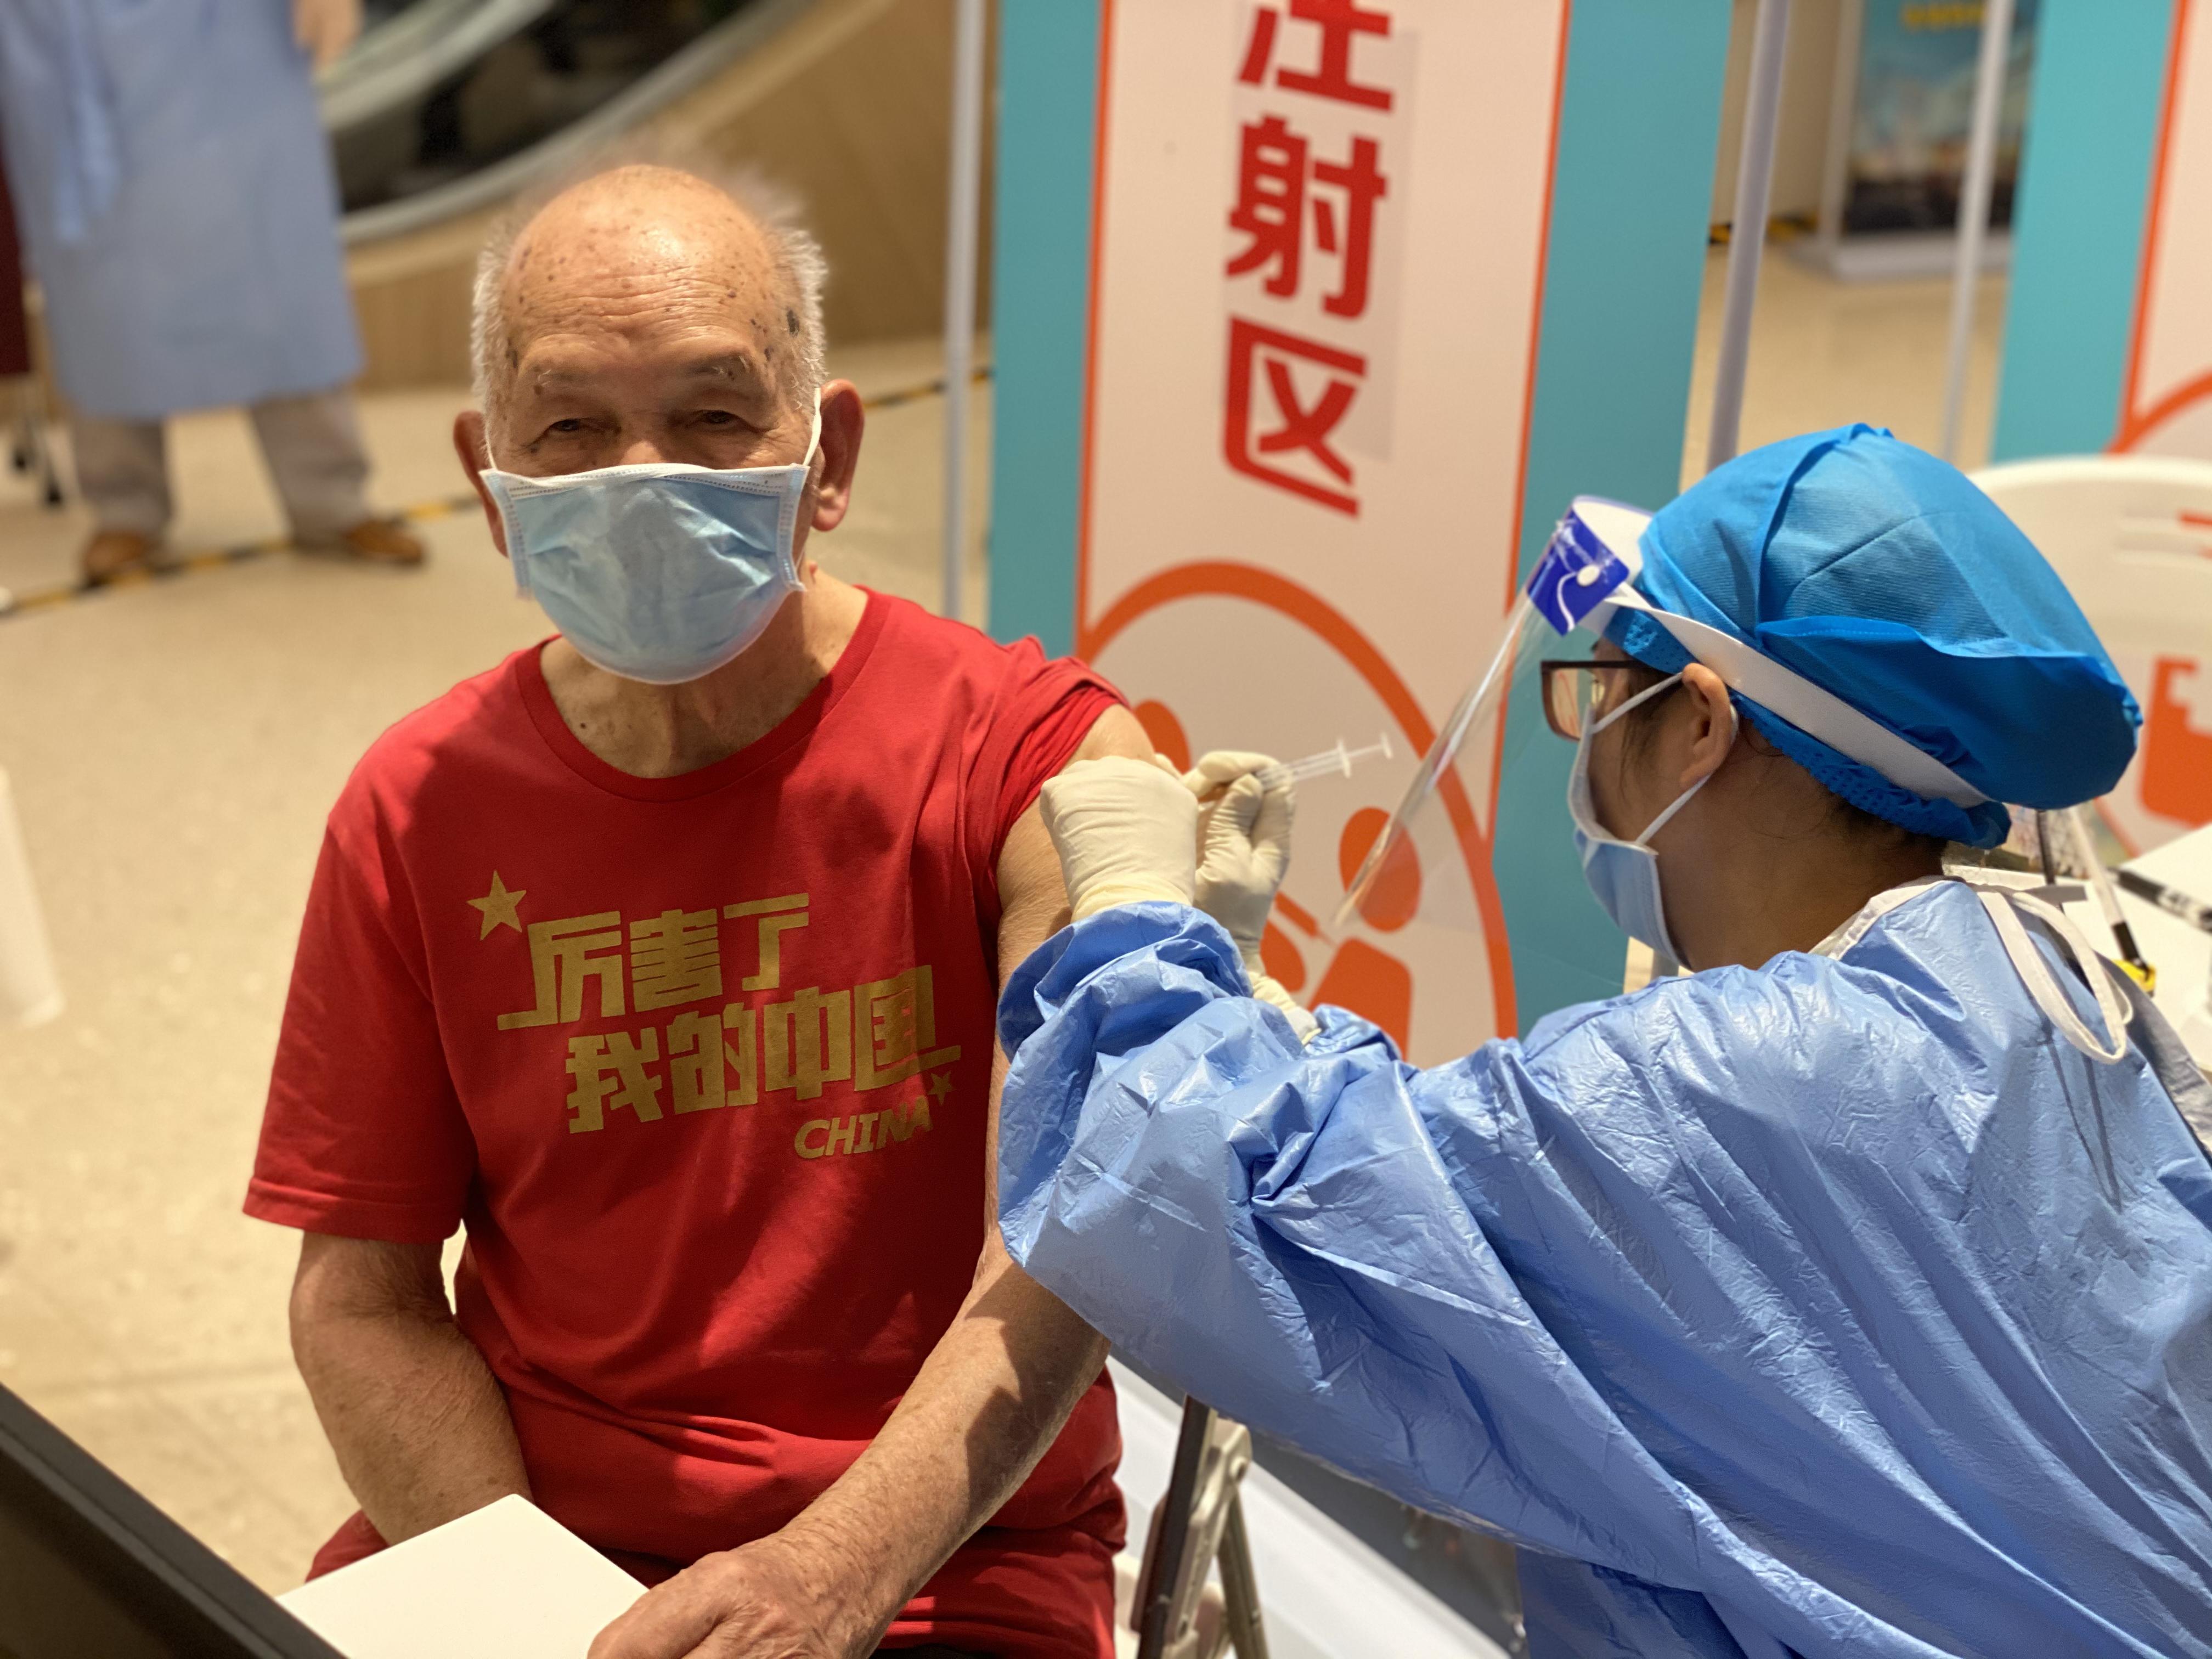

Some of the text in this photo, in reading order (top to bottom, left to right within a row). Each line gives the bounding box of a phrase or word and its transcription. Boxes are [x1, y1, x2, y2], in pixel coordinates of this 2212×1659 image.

[496, 892, 810, 1031] 厉害了
[565, 964, 962, 1135] 我的中国
[794, 1095, 933, 1159] CHINA
